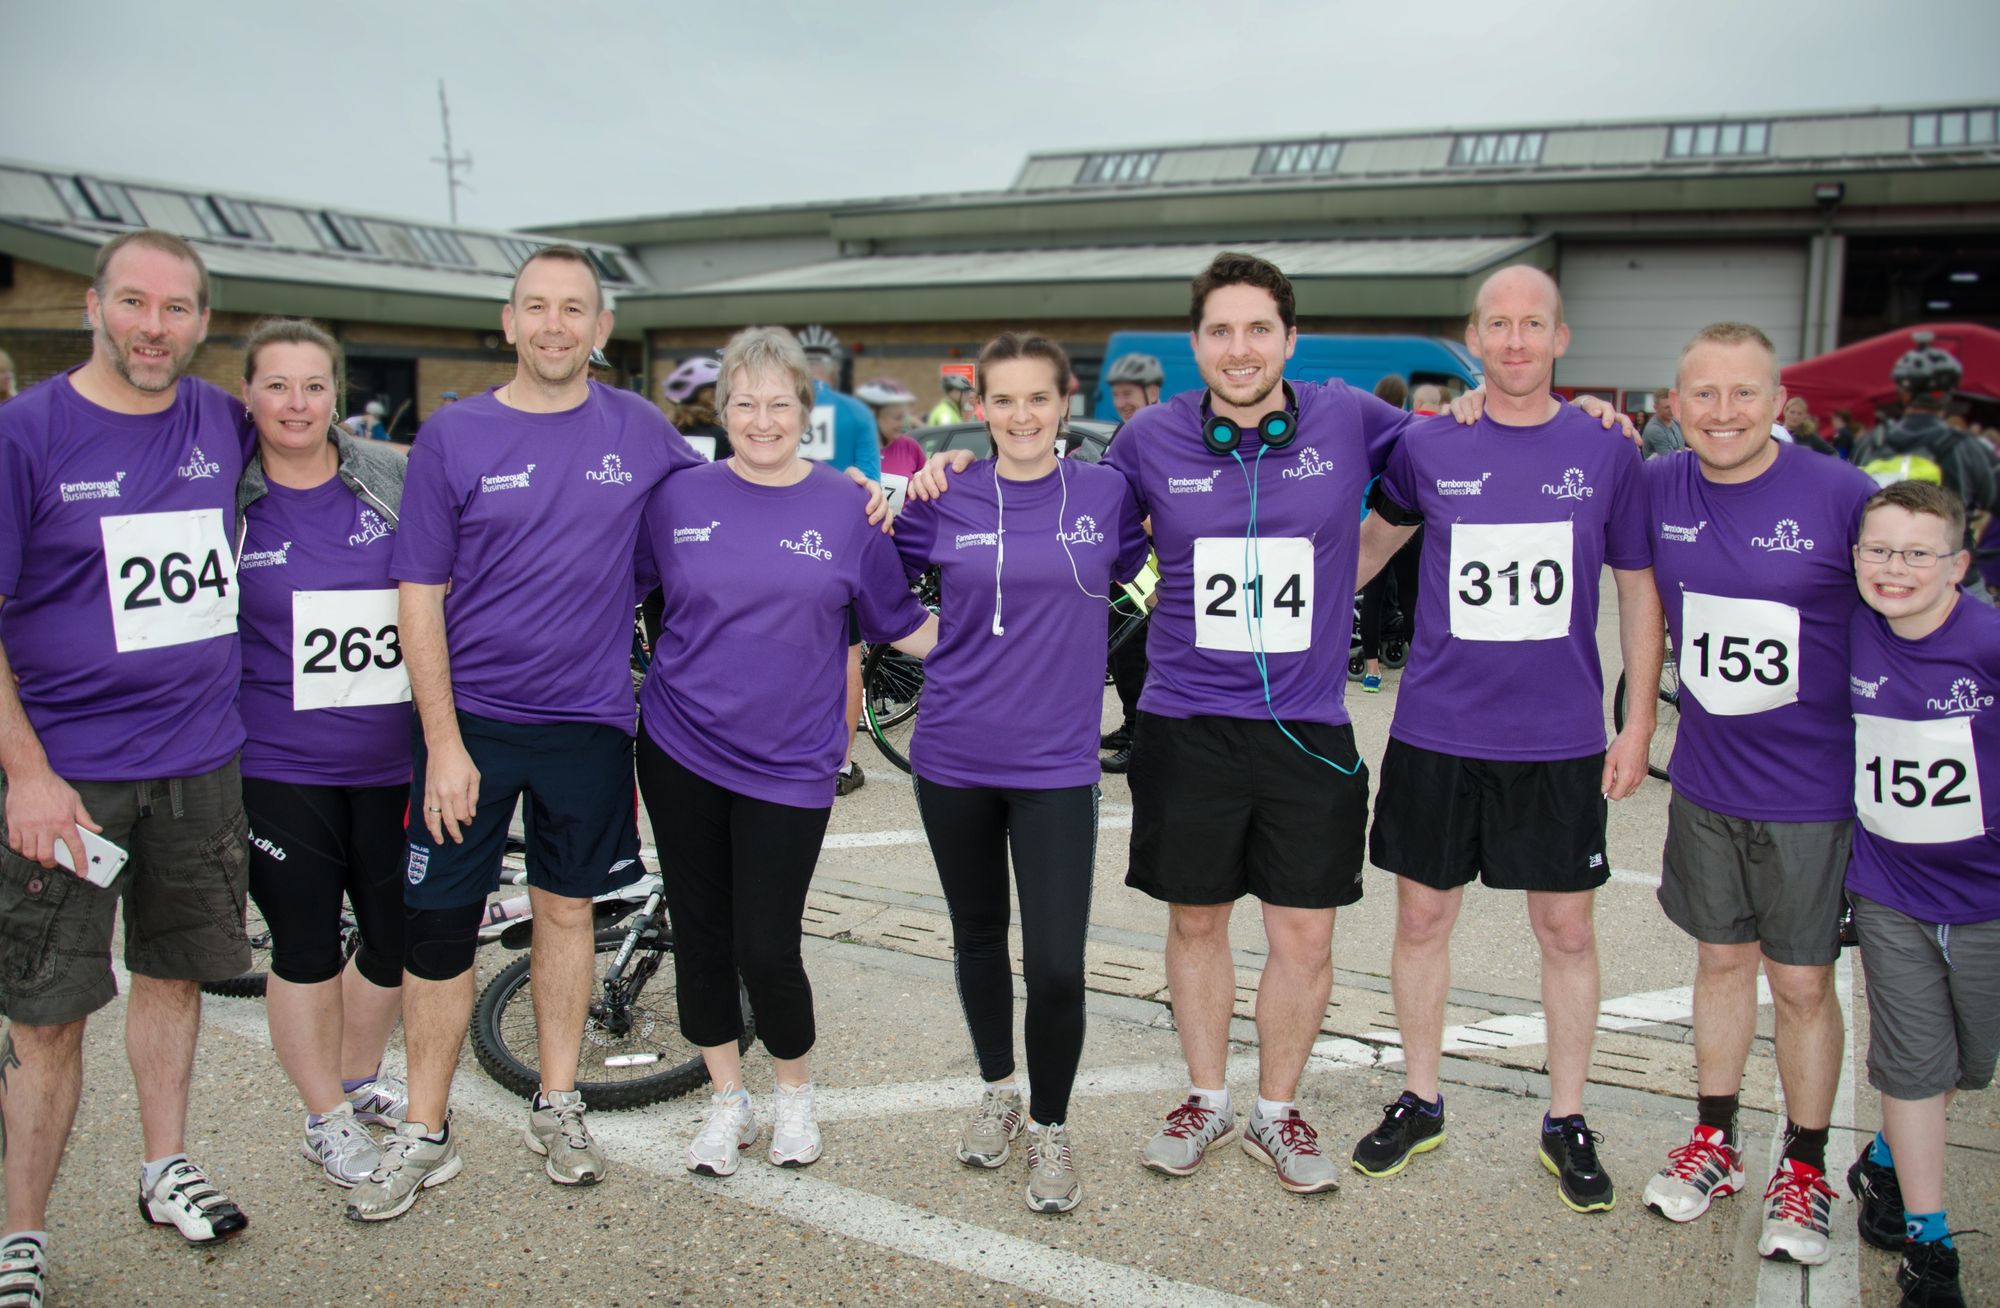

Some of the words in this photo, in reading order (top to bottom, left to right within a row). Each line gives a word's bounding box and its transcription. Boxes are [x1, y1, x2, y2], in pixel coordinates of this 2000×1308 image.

[177, 460, 220, 478] nurture
[586, 467, 632, 482] nurture
[1282, 460, 1333, 479] nurture
[60, 480, 119, 493] Farnborough
[481, 472, 529, 485] Farnborough
[1168, 477, 1213, 487] Farnborough
[1436, 479, 1482, 488] Farnborough
[1541, 482, 1593, 497] nurture
[349, 521, 394, 546] nurture
[1056, 530, 1104, 543] nurture
[1751, 534, 1814, 550] nurture
[780, 538, 832, 560] nurture
[119, 548, 228, 611] 264
[1458, 559, 1564, 606] 310
[1205, 573, 1305, 619] 214
[302, 624, 403, 674] 263
[1692, 632, 1789, 686] 153
[1927, 694, 1994, 710] nurture
[1865, 755, 1971, 808] 152
[254, 838, 287, 861] dhb
